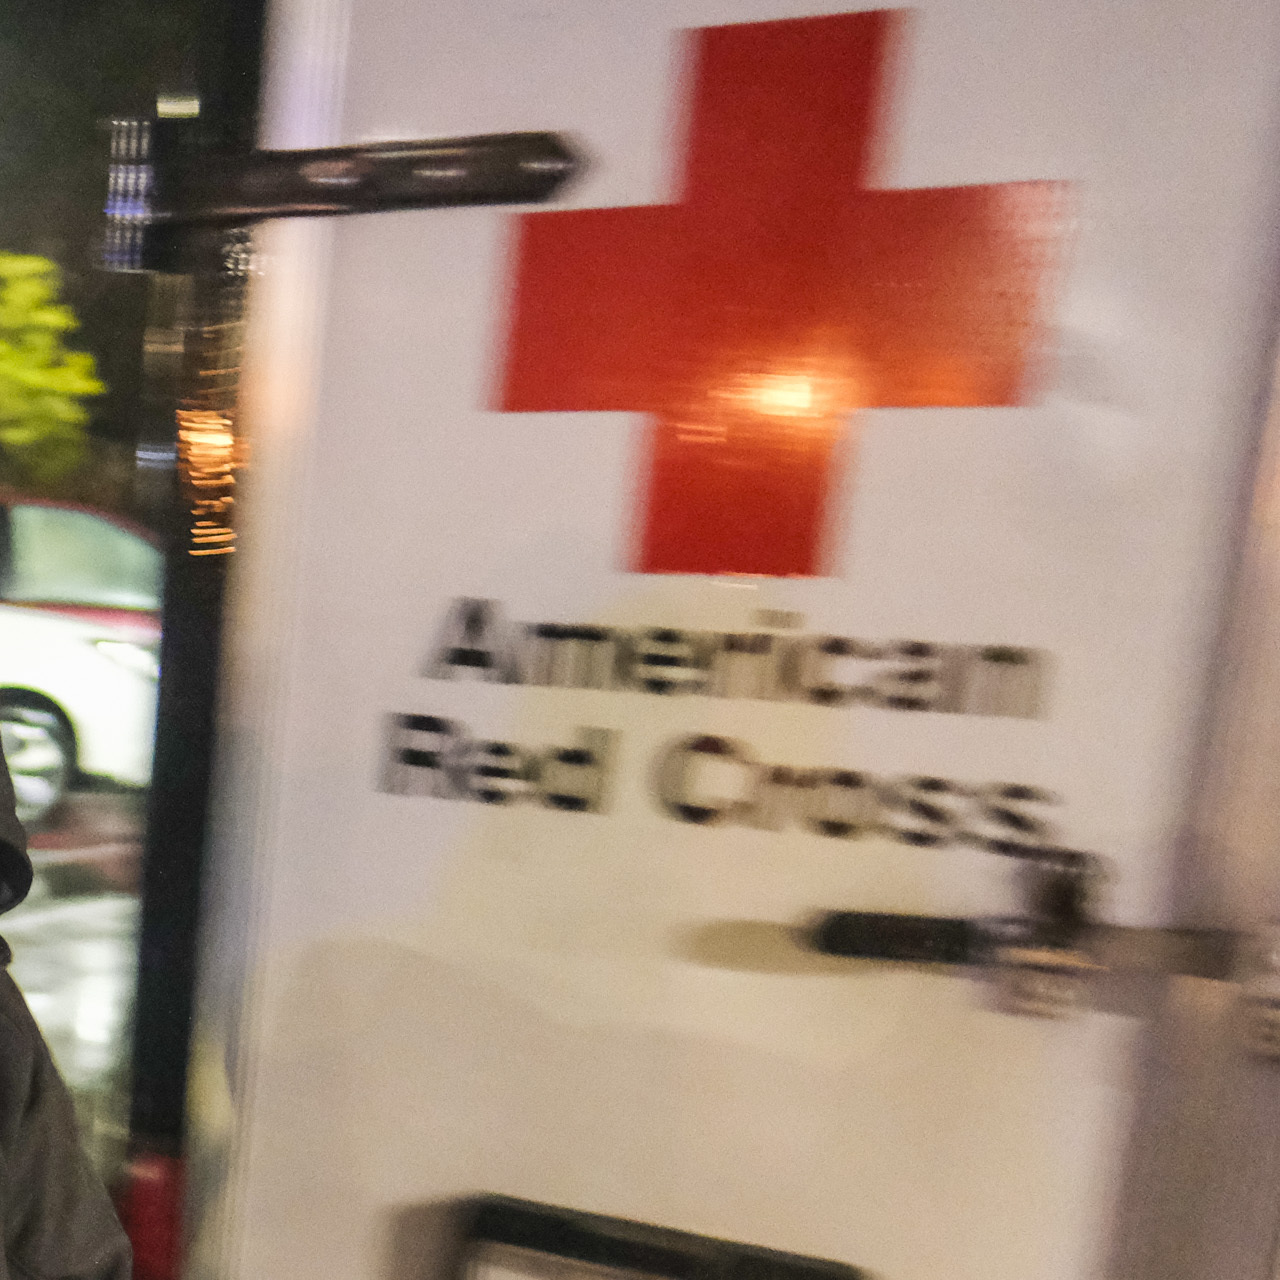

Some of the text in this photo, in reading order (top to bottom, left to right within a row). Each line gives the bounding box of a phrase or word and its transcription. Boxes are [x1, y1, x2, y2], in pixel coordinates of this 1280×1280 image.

[424, 597, 1050, 718] American
[378, 712, 1064, 856] Red Cross
